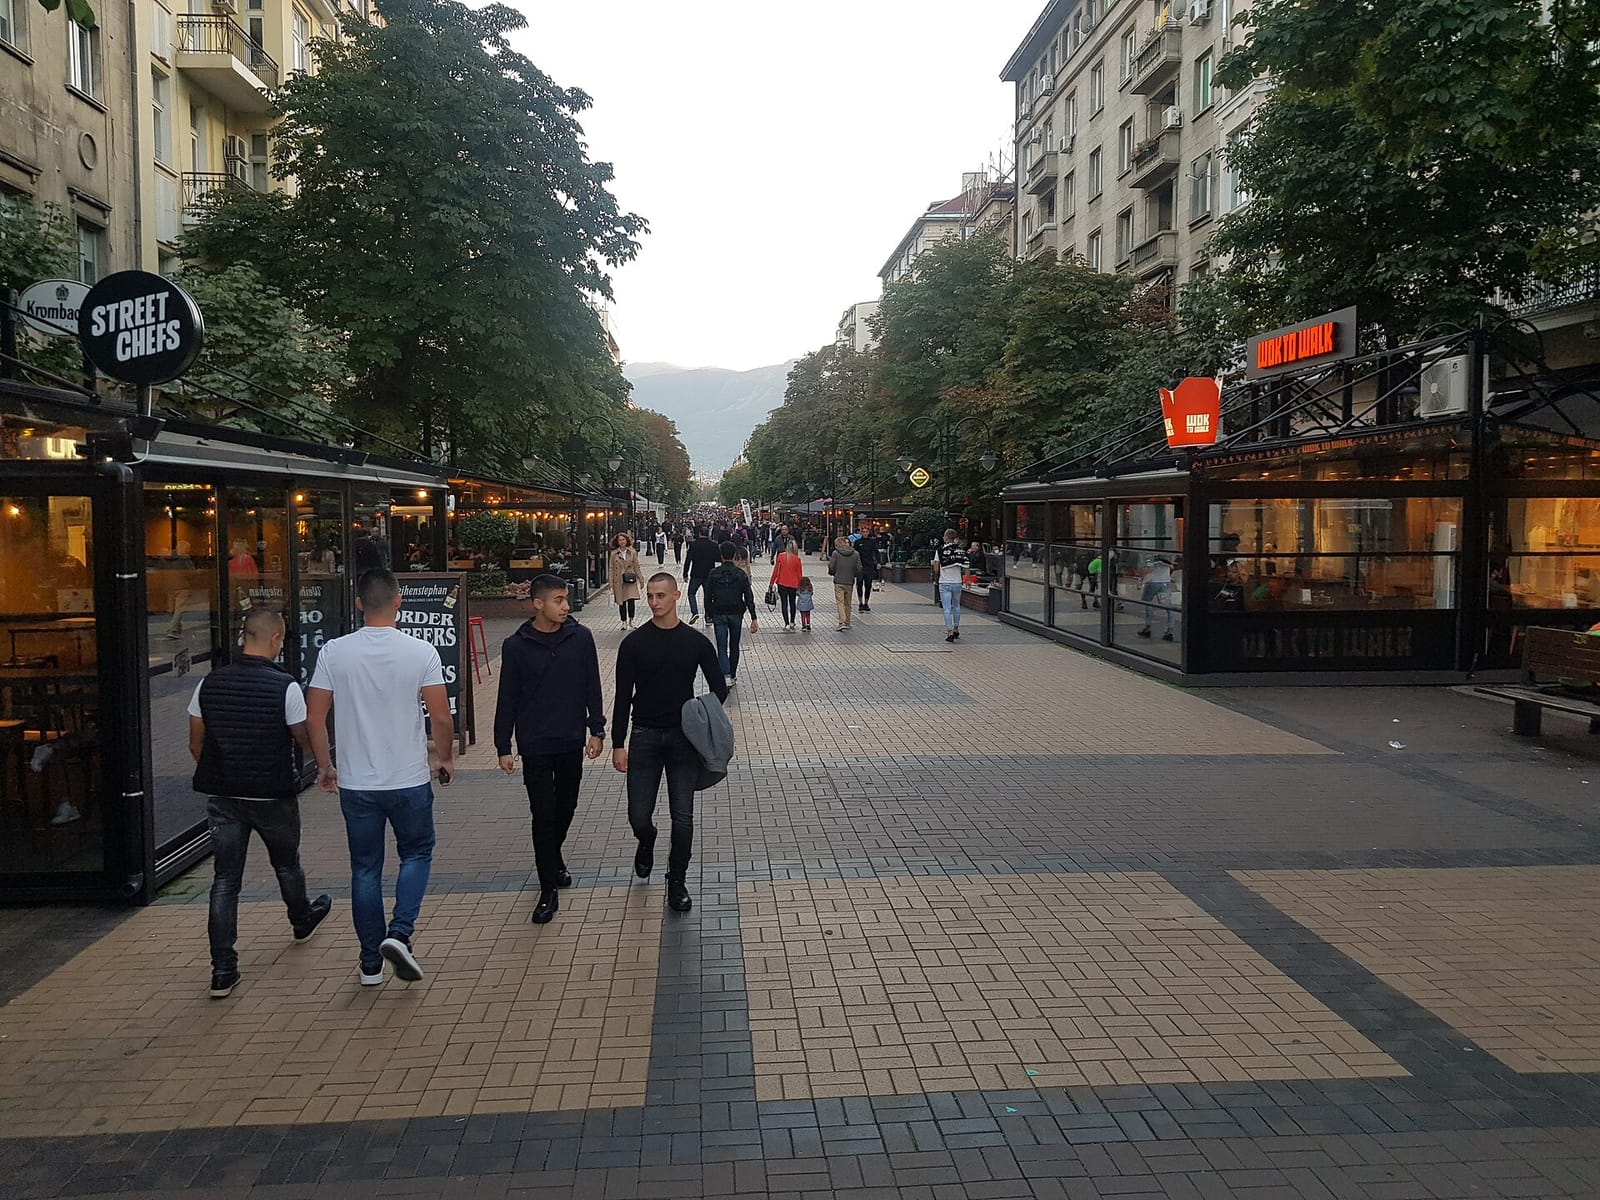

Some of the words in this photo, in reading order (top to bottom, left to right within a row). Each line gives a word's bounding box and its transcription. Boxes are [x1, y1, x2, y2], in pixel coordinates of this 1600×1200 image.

[91, 291, 169, 337] STREET
[116, 319, 181, 362] CHEFS
[1257, 335, 1282, 369] WOK
[1283, 331, 1297, 362] TO
[1298, 320, 1334, 359] WALK
[1186, 413, 1210, 426] WOK
